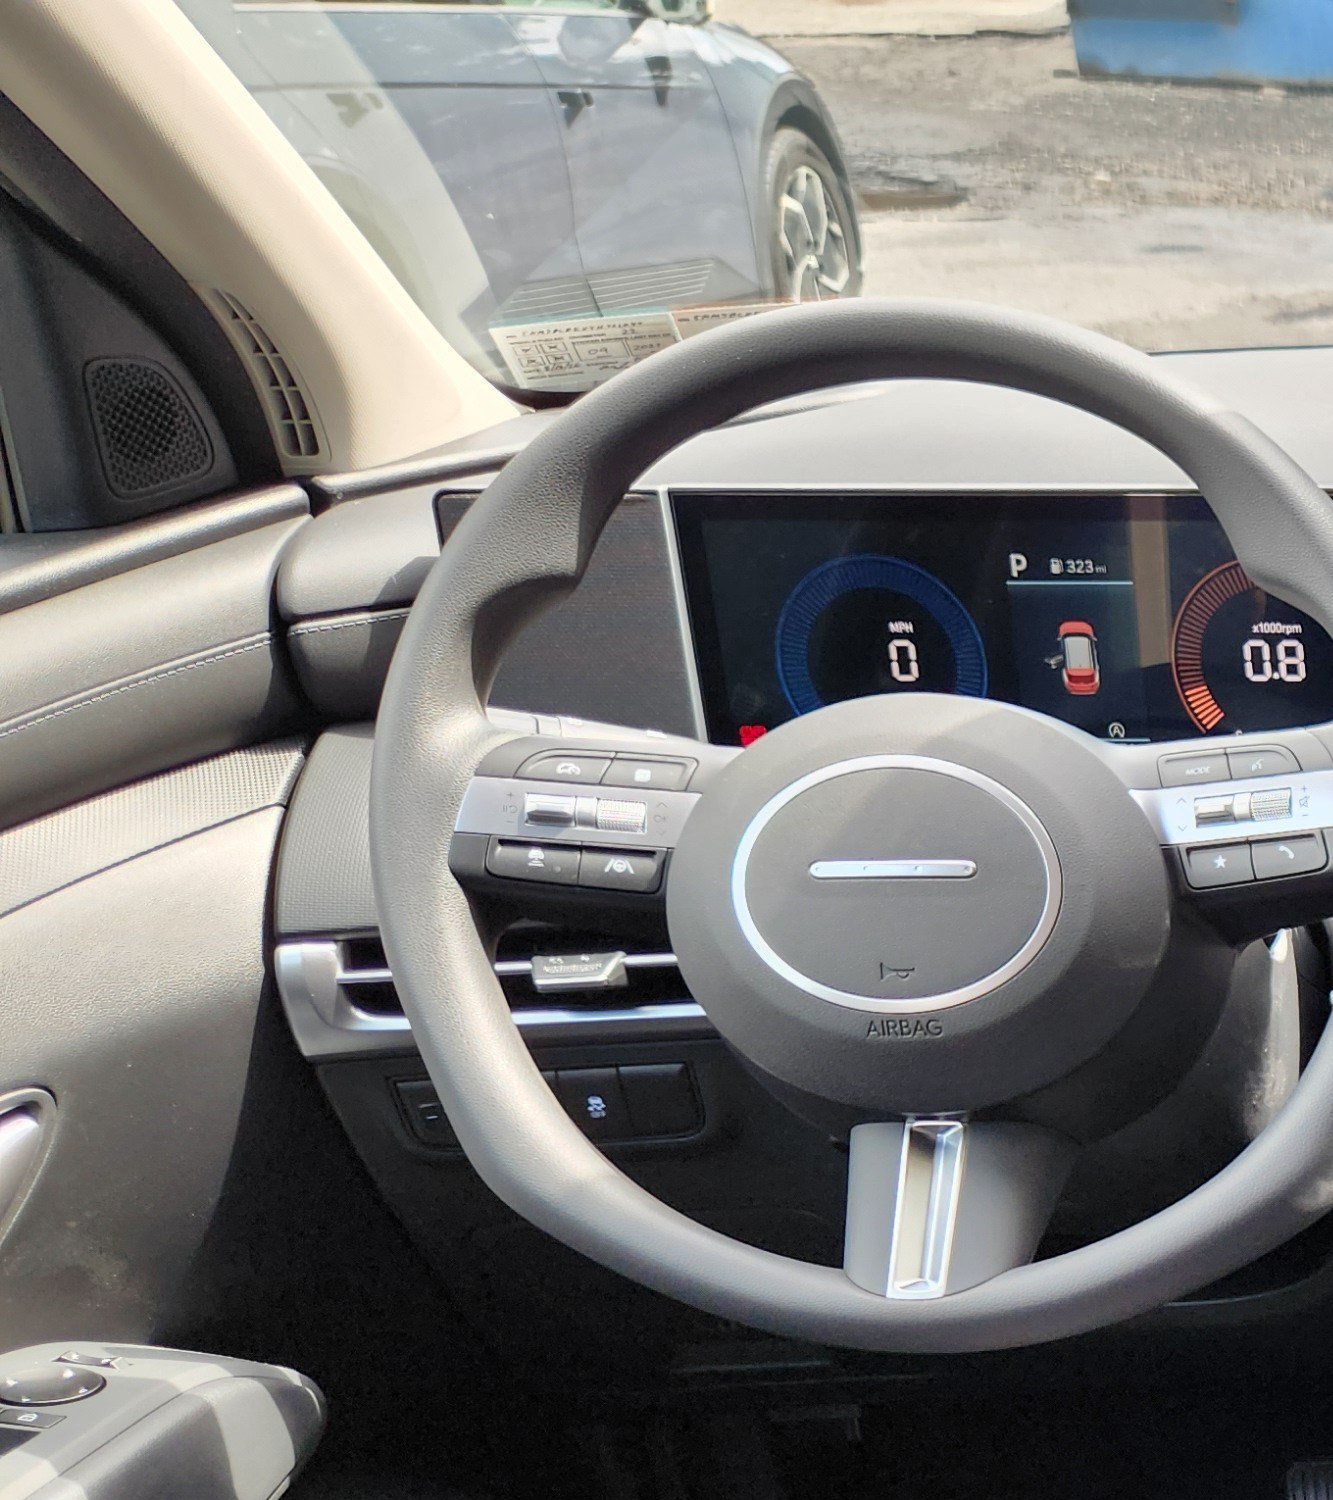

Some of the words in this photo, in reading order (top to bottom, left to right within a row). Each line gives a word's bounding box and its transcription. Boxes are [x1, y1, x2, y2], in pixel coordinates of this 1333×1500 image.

[1009, 553, 1028, 578] P
[1066, 558, 1094, 574] 323
[888, 621, 914, 633] MPH
[1252, 621, 1303, 635] x1000rpm
[888, 639, 920, 682] 0
[1242, 639, 1307, 682] 0.8
[866, 1019, 943, 1038] AIRBAG
